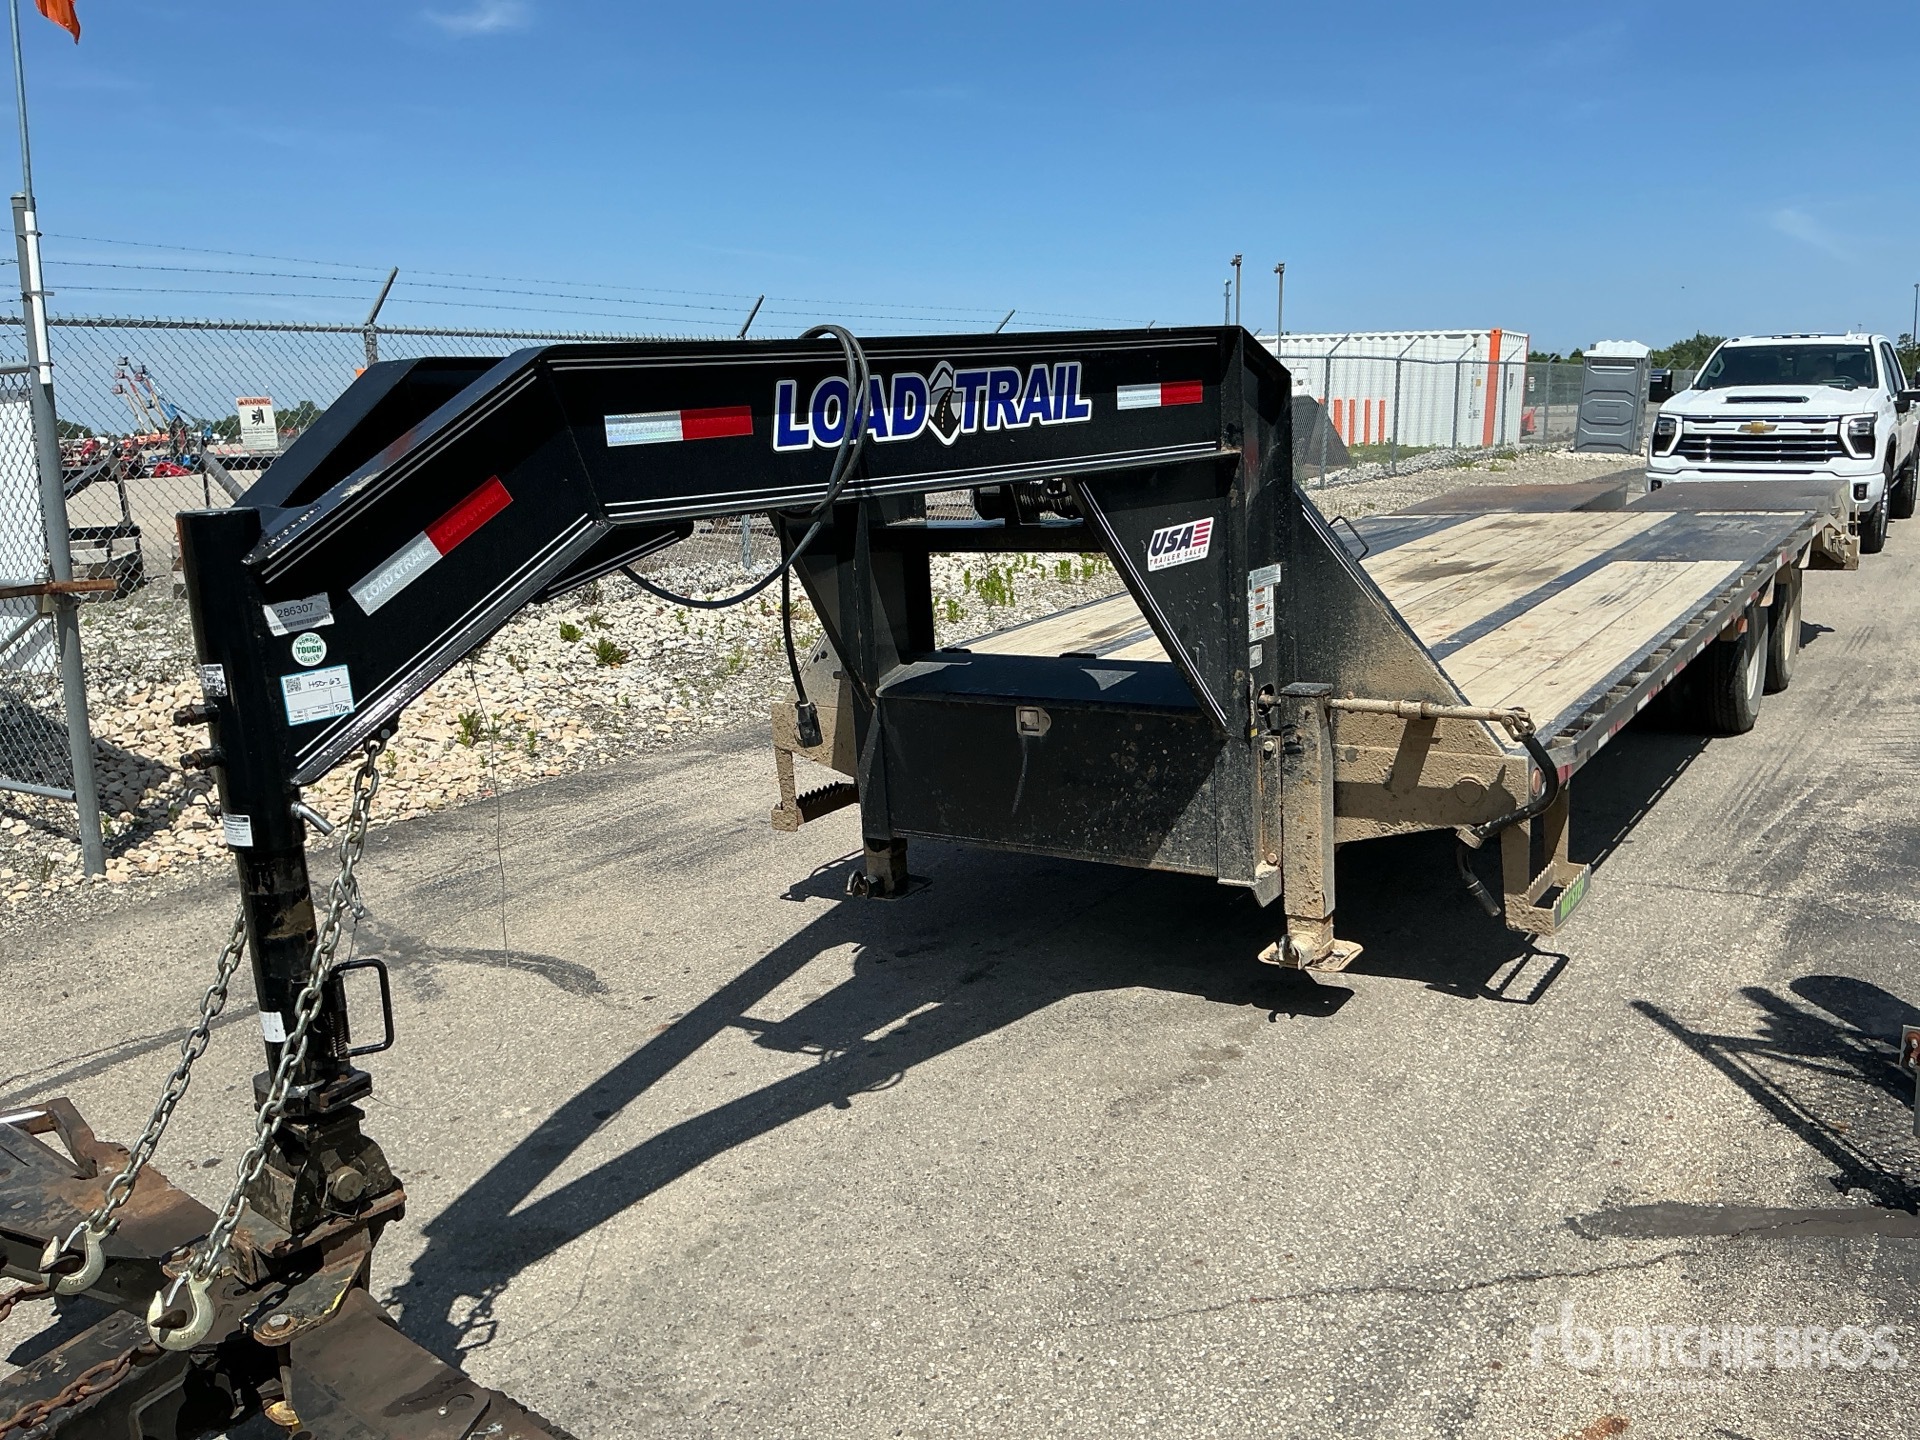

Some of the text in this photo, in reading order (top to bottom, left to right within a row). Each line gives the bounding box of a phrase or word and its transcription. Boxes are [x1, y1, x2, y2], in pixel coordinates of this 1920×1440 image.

[773, 361, 1092, 452] LOAD TRAIL
[1151, 525, 1194, 557] USA
[1150, 553, 1180, 565] TRAILER
[1184, 547, 1207, 557] SALES
[277, 602, 314, 618] 286307
[296, 645, 322, 654] TOUGH
